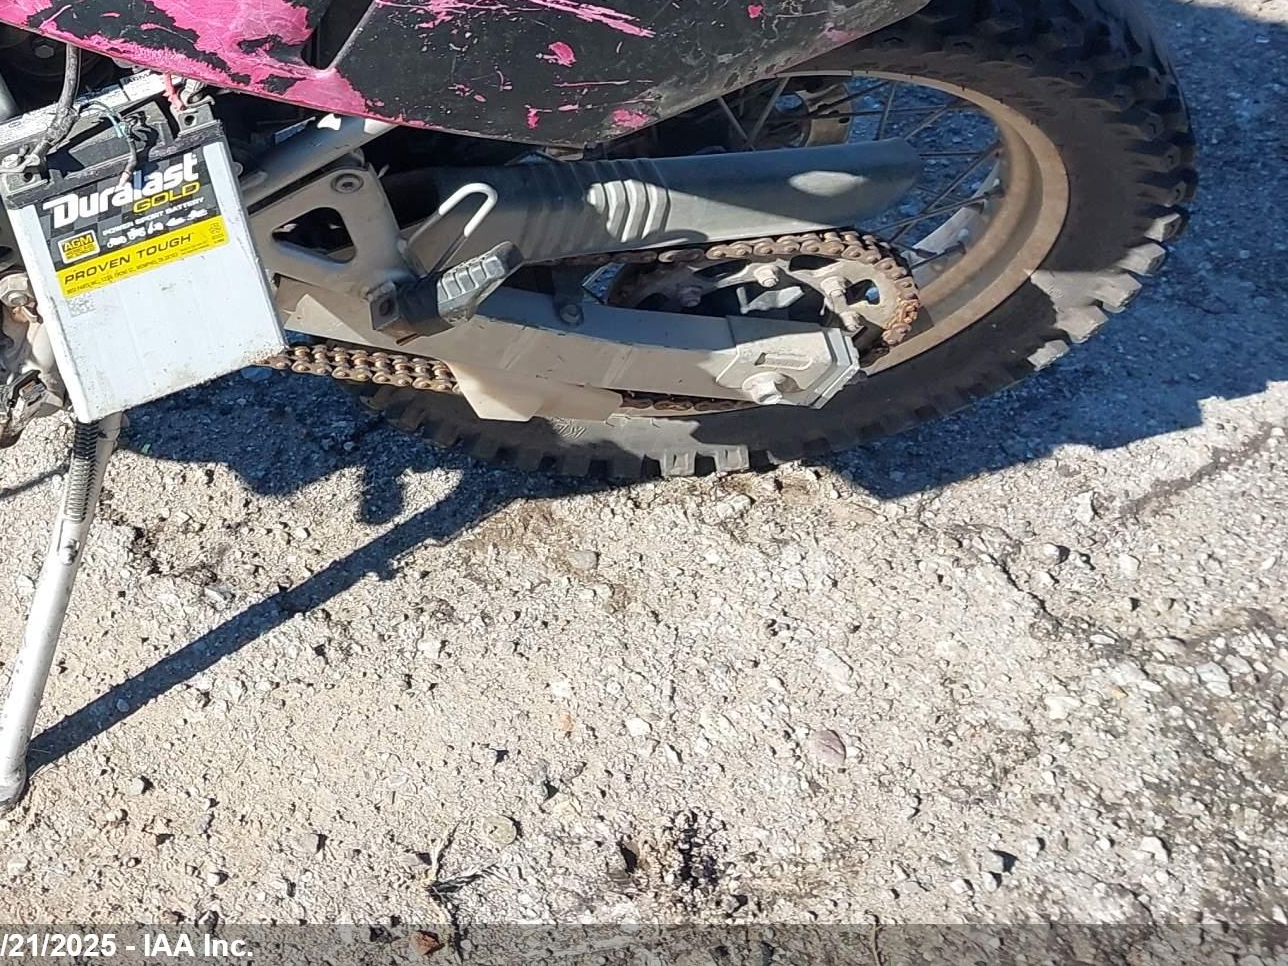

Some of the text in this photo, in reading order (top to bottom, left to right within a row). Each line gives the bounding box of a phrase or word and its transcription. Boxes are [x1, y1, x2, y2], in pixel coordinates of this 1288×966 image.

[43, 152, 200, 229] Duralast
[133, 181, 201, 214] GOLD
[165, 197, 205, 215] BATTERY
[63, 233, 94, 252] AGM
[64, 254, 131, 285] PROVEN
[136, 234, 192, 260] TOUGH
